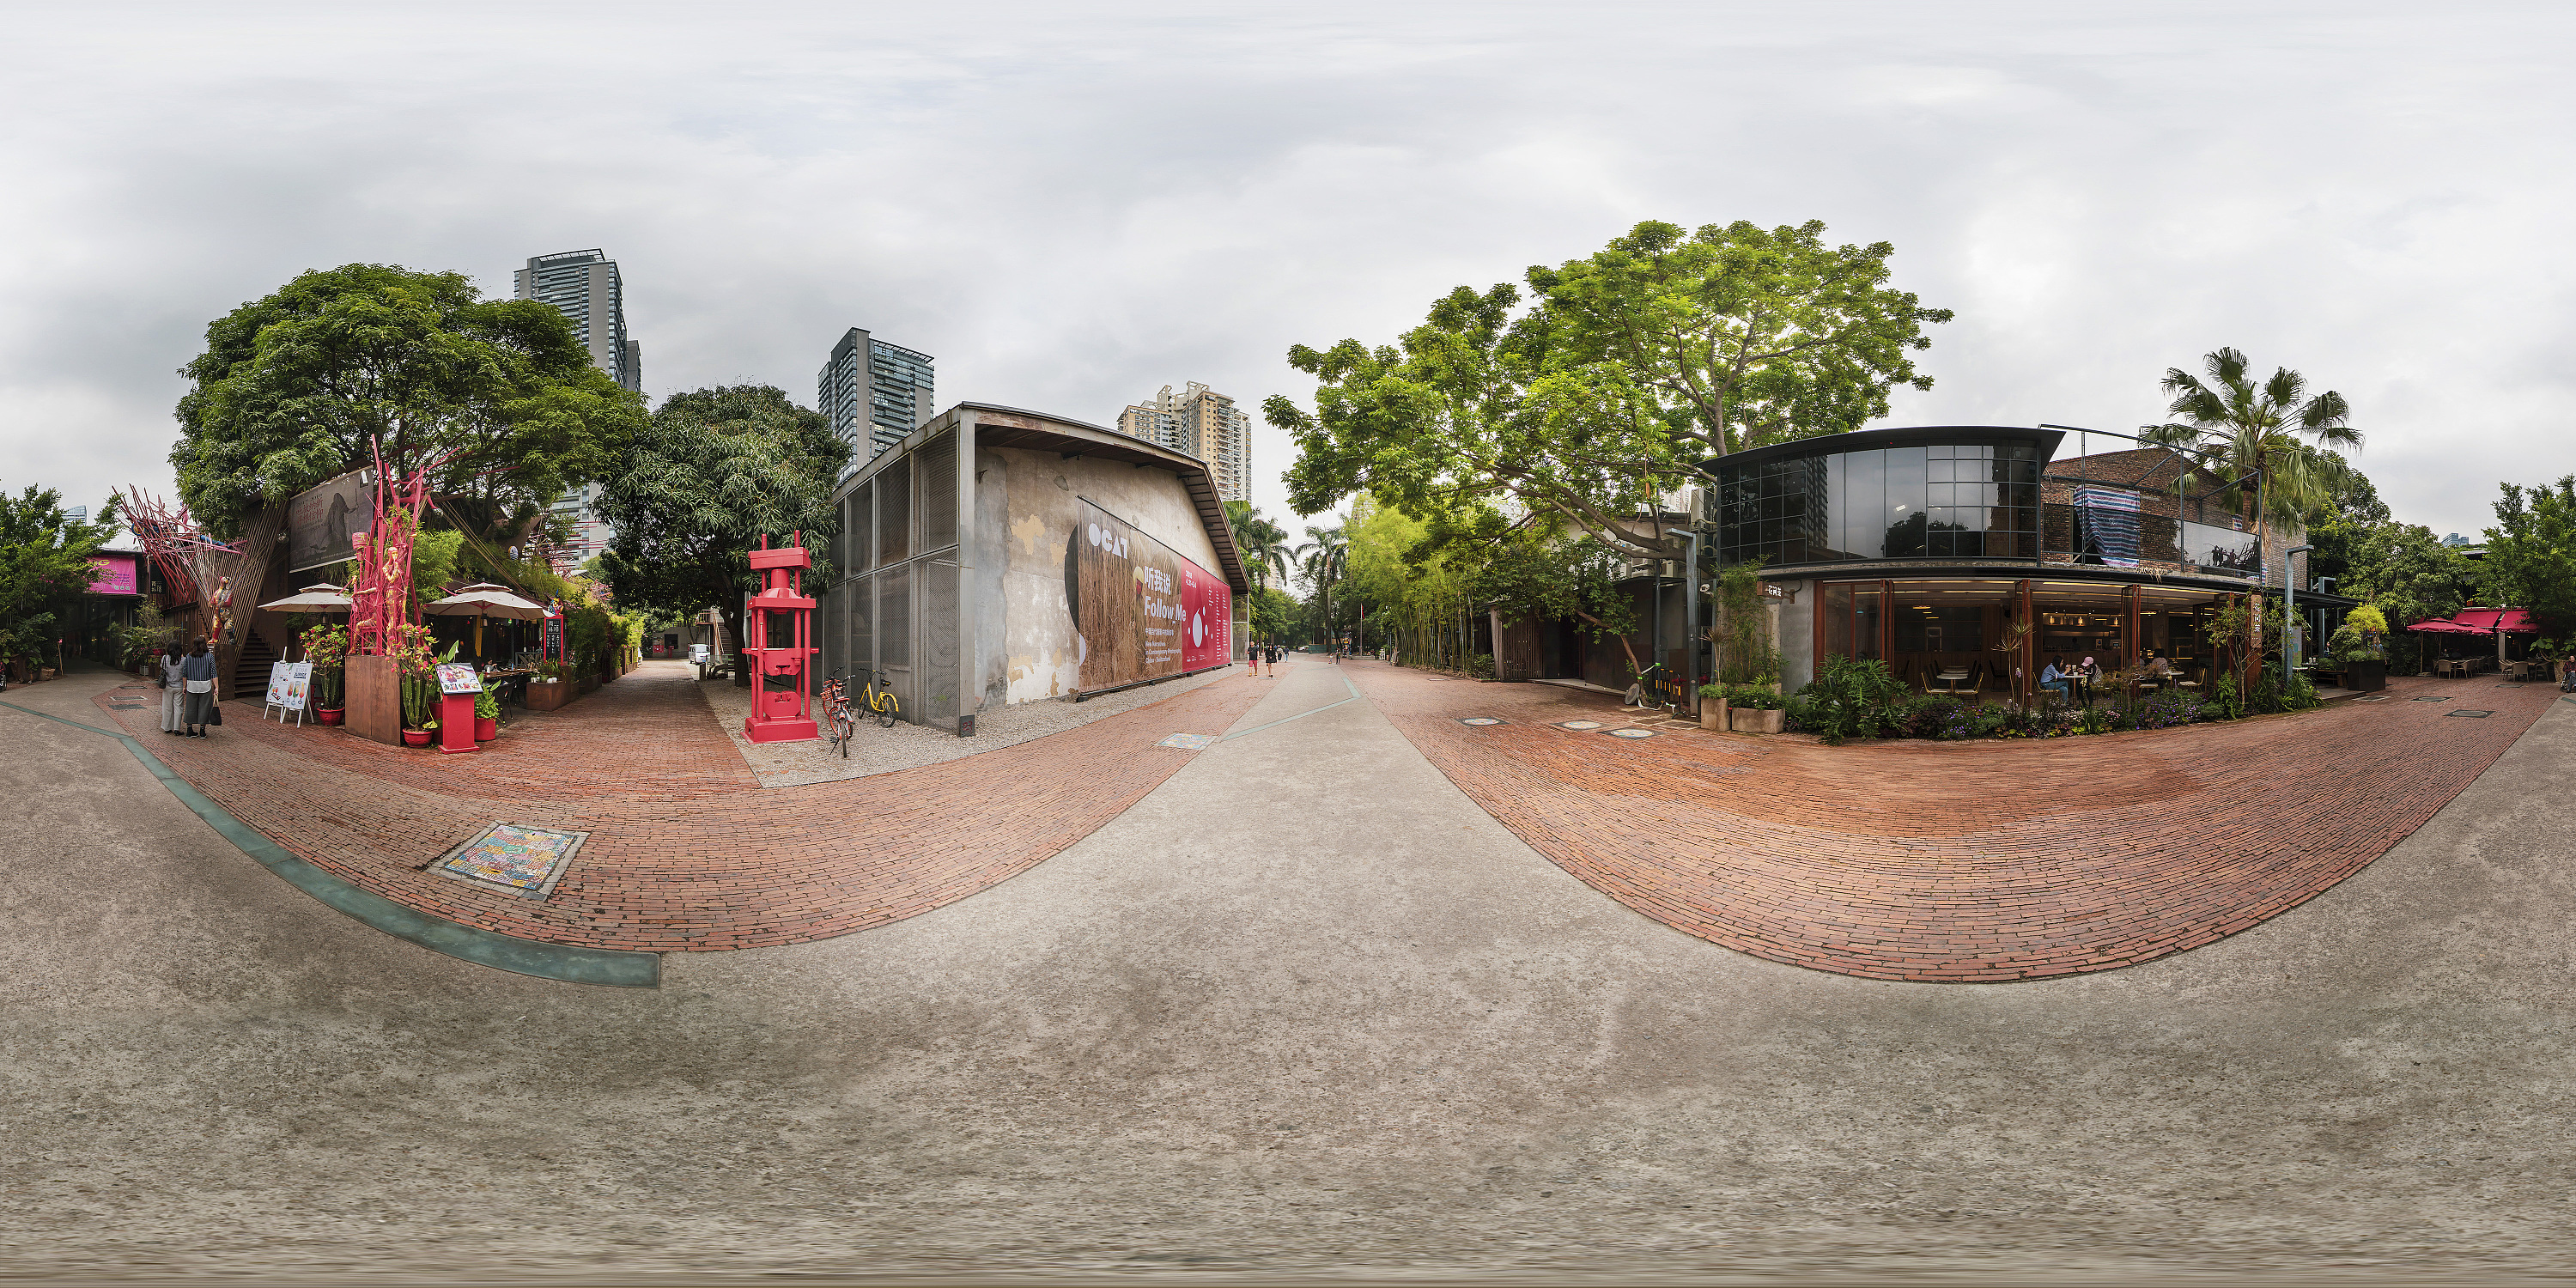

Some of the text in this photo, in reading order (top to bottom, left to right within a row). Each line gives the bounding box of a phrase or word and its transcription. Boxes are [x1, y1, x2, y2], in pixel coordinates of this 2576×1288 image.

[1088, 522, 1128, 560] OCAT
[1144, 565, 1171, 595] 听我说
